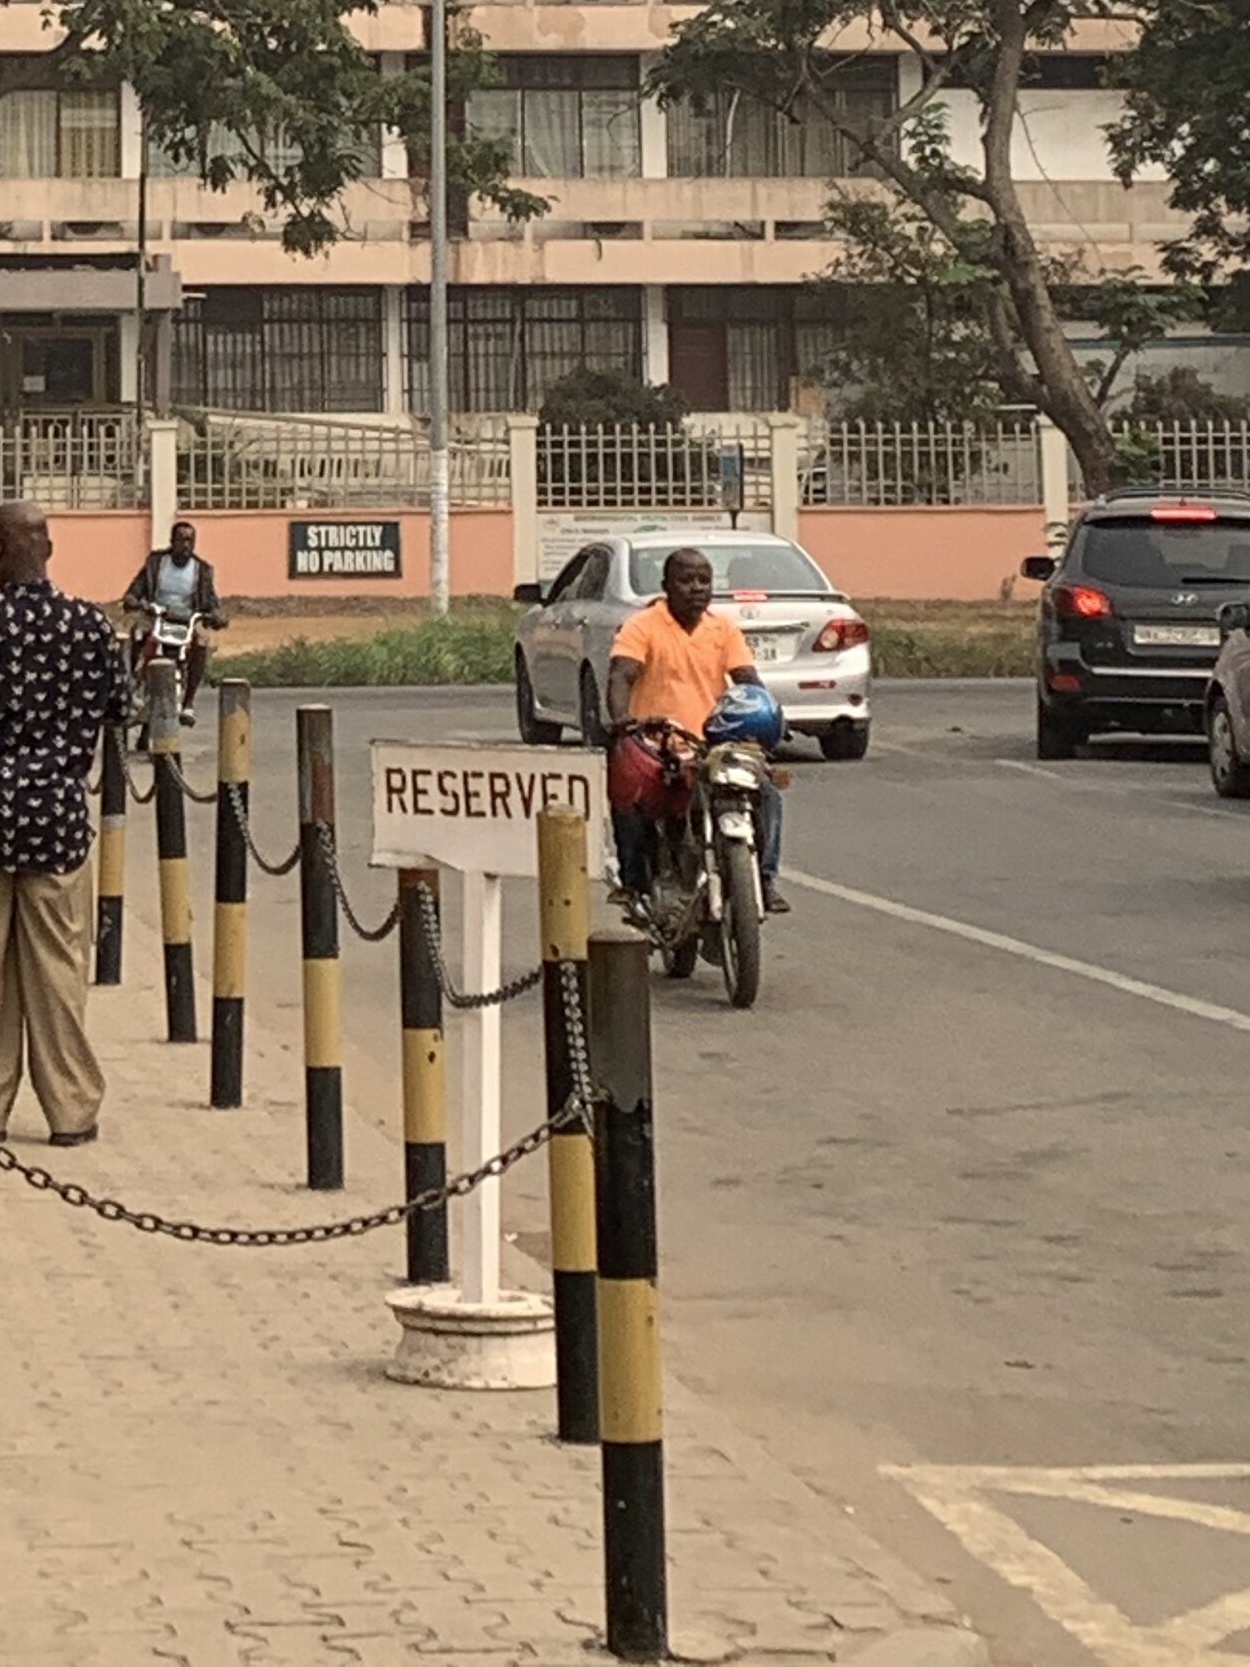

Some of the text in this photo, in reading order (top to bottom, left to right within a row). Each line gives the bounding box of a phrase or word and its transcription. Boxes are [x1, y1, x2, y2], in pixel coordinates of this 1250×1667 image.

[306, 525, 383, 548] STRICTLY
[296, 548, 395, 573] NO PARKING
[385, 767, 591, 821] RESERVED
